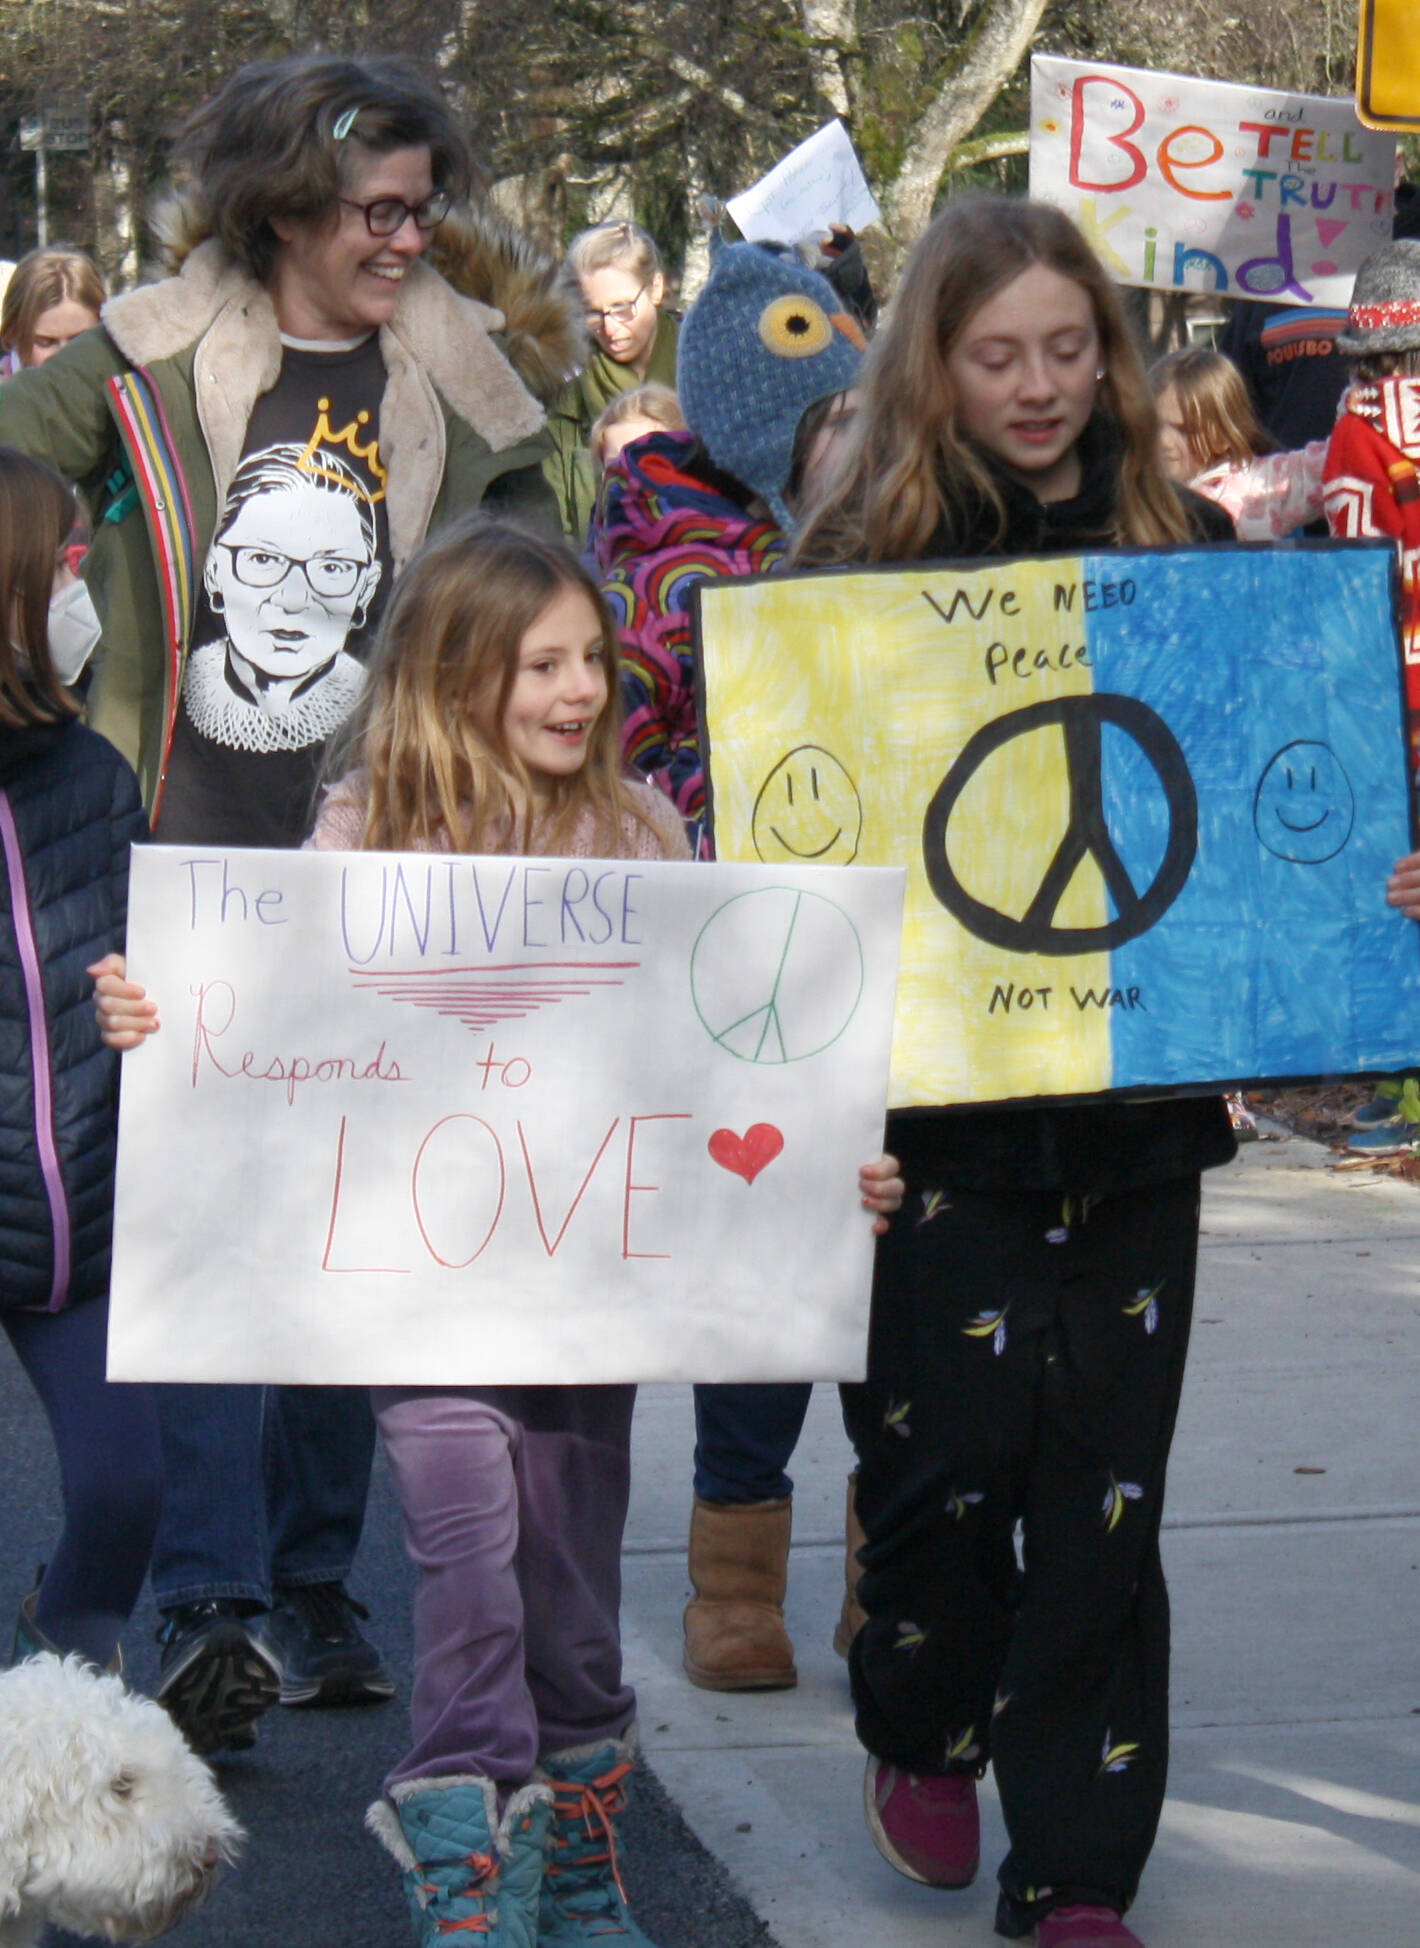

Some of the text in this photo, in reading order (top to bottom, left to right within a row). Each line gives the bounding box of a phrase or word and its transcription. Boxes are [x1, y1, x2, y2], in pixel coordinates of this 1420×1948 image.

[1264, 107, 1305, 122] and
[1069, 75, 1233, 201] Be
[1239, 121, 1364, 163] TELL
[1243, 169, 1393, 215] TRUTH
[921, 578, 1137, 624] We NEED
[179, 859, 643, 965] The UNIVERSE
[988, 983, 1148, 1014] NOT WAR
[189, 981, 532, 1106] Responds to
[322, 1113, 693, 1274] LOVE
